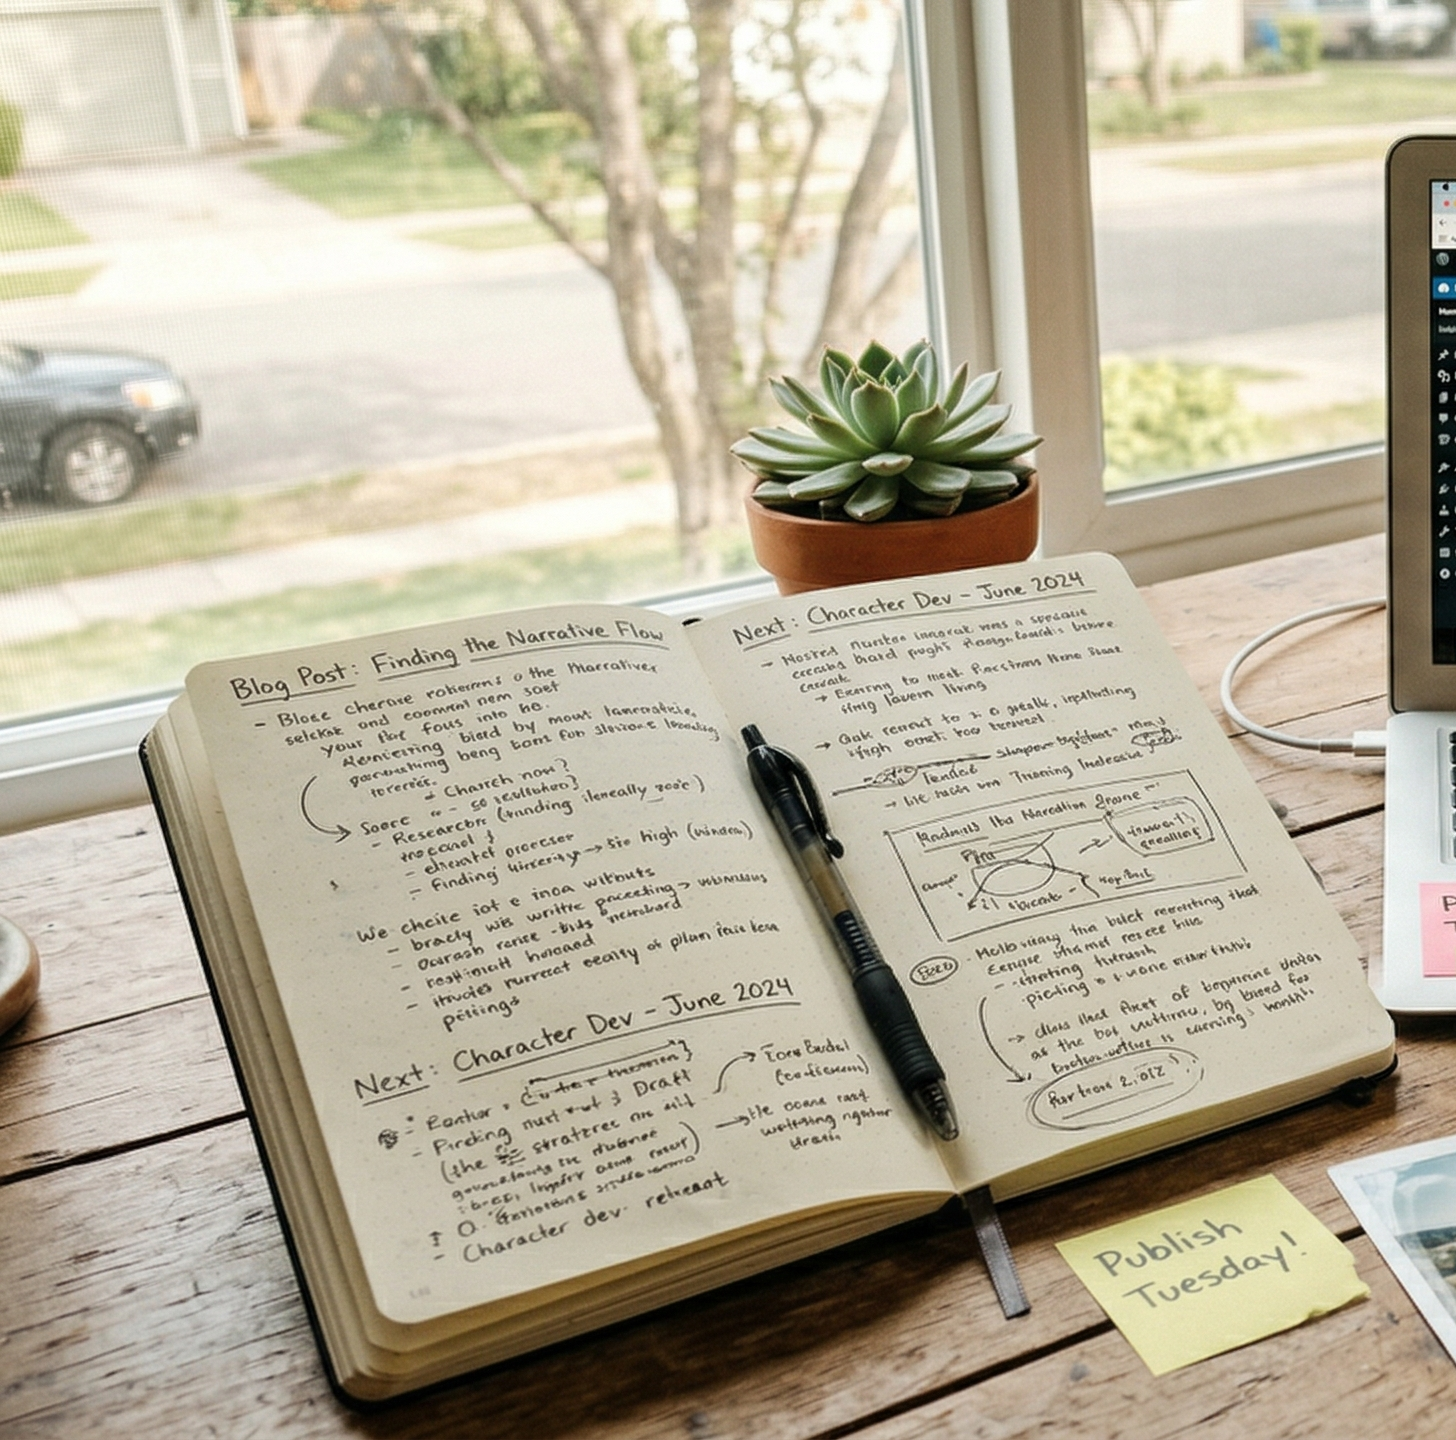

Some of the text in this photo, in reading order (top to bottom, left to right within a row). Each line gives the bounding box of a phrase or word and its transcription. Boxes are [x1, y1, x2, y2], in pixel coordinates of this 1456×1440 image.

[807, 597, 906, 625] Character
[912, 591, 952, 609] Dev
[977, 583, 1027, 601] June
[1031, 571, 1086, 592] 2024
[229, 620, 664, 701] Blog Post: Finding the Narrative Flow
[476, 708, 508, 724] into
[356, 924, 390, 943] We
[353, 1062, 439, 1101] Next:
[452, 1024, 578, 1073] Character
[586, 1011, 633, 1036] Dev
[662, 991, 727, 1017] June
[732, 977, 795, 1002] 2024
[462, 1221, 570, 1263] Character
[1093, 1219, 1243, 1278] Publish
[1122, 1231, 1308, 1308] Tuesday!
